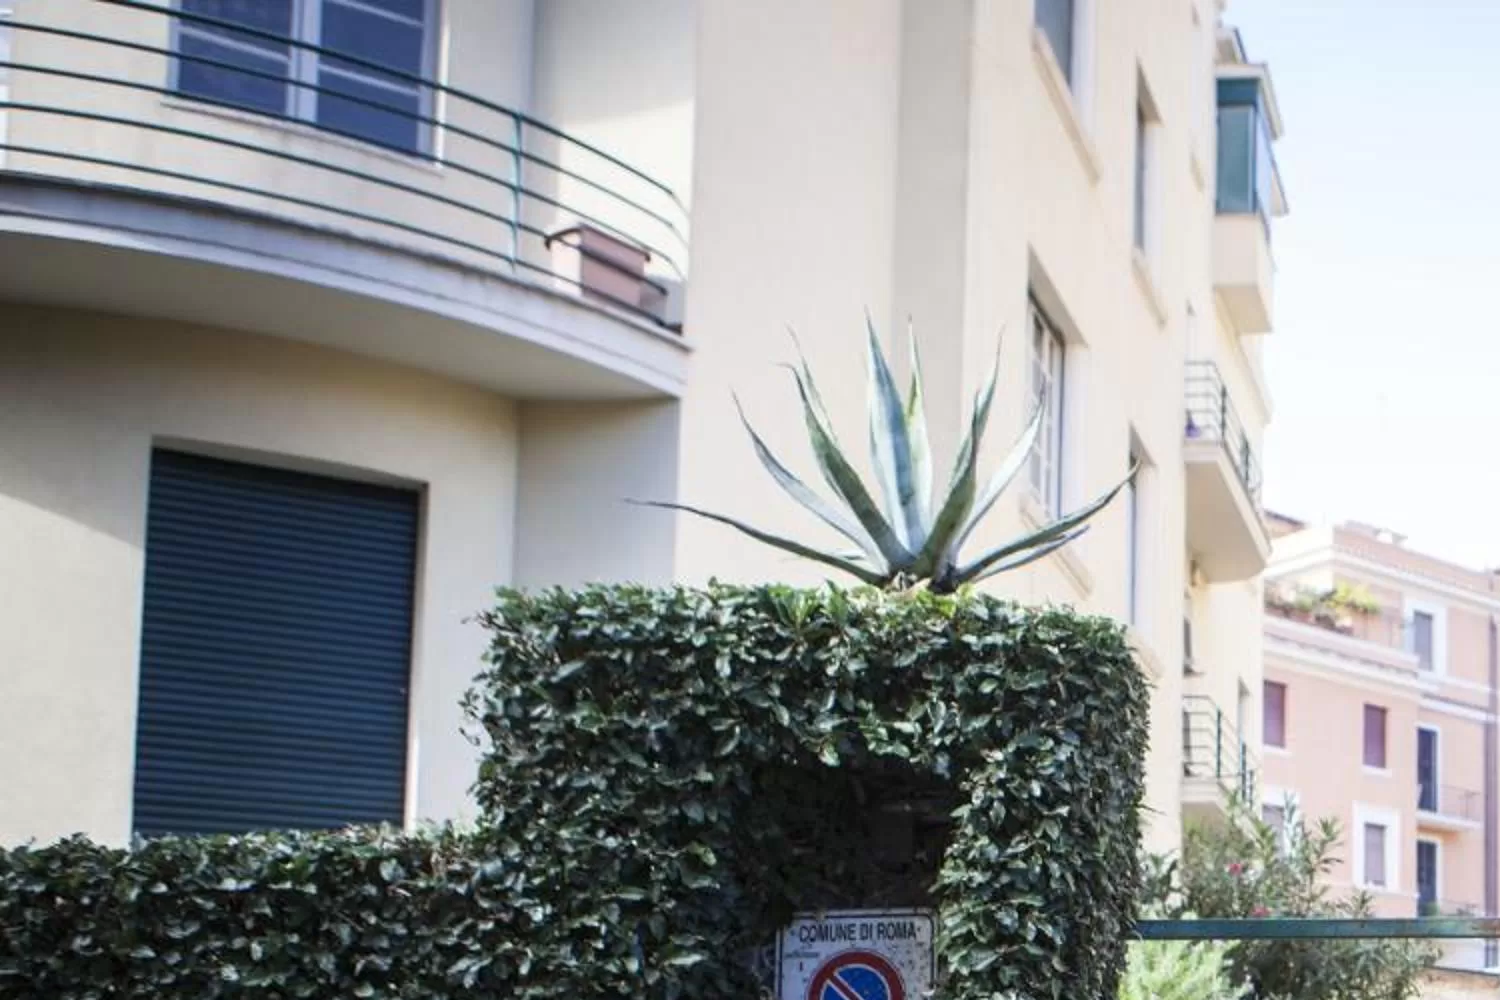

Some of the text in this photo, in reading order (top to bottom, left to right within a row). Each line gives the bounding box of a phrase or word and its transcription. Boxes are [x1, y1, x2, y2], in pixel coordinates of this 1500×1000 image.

[799, 922, 917, 943] COMUNE DI ROMA
